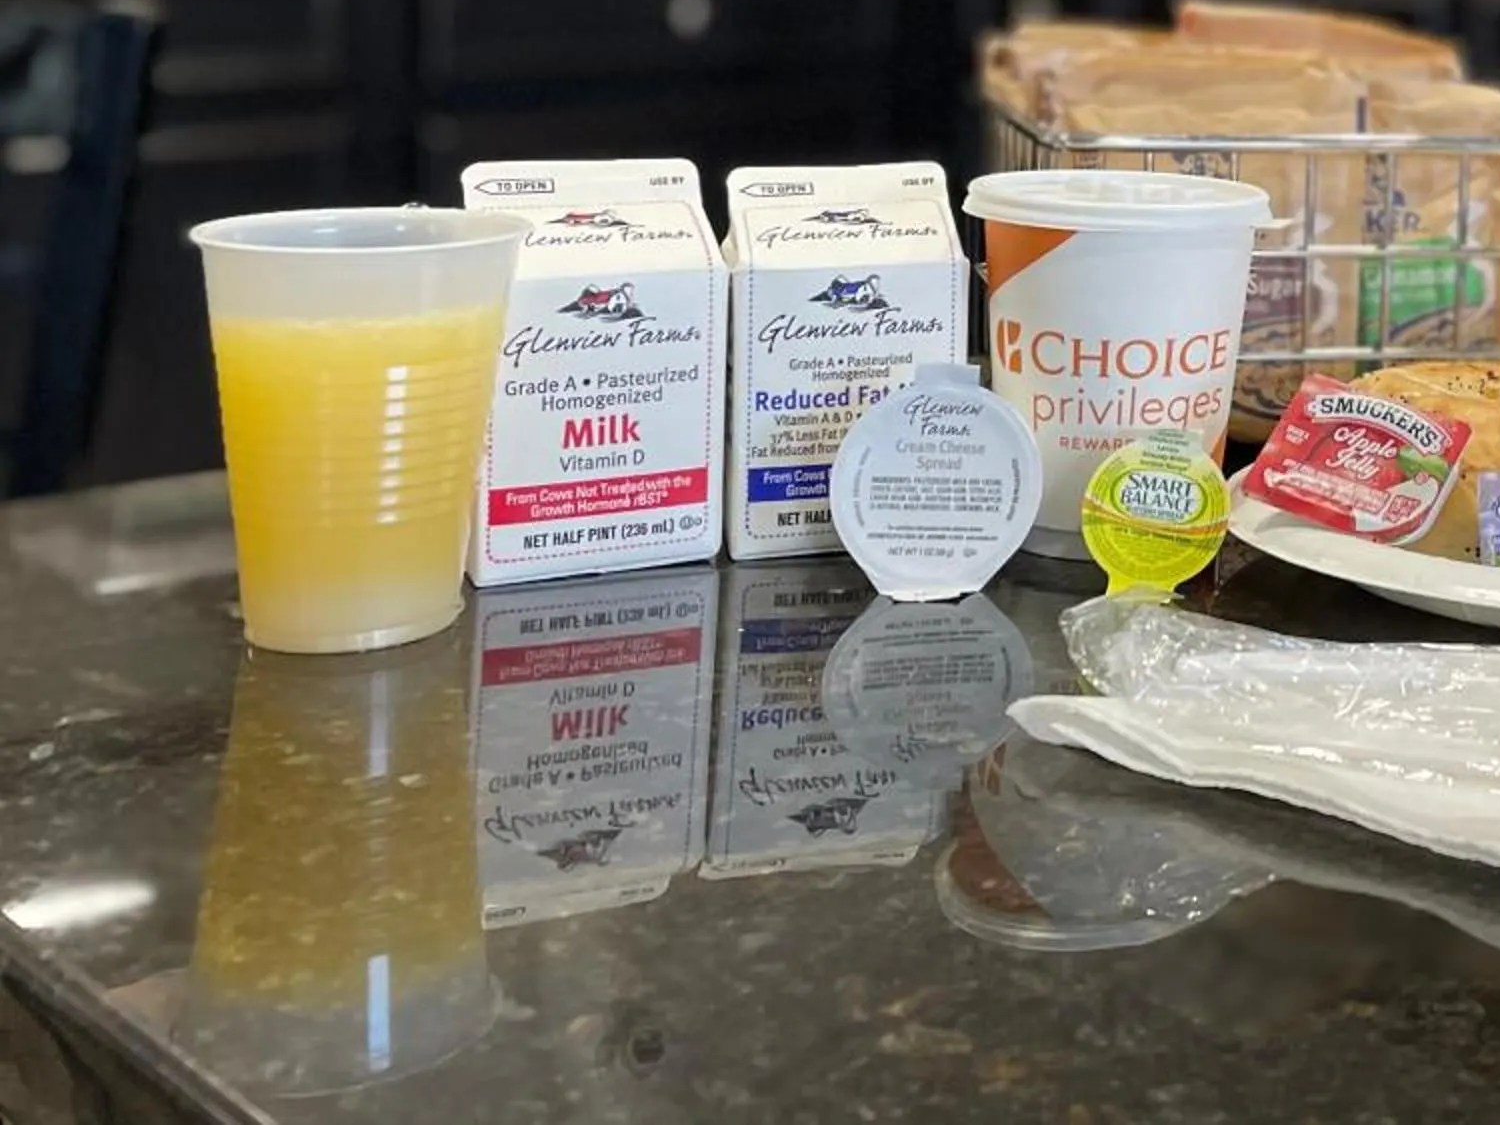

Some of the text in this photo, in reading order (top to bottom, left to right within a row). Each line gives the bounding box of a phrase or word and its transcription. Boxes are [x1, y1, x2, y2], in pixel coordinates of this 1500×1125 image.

[497, 181, 547, 192] TO OPEN
[650, 176, 684, 186] USE BY
[525, 229, 613, 247] lenview
[756, 226, 860, 248] Glenview
[758, 307, 943, 353] Glenview Farms
[504, 317, 700, 367] Glenview Farms
[789, 353, 913, 371] Grade A Pasteurized
[1031, 329, 1230, 379] CHOICE
[504, 365, 699, 397] Grade A Pasteurized
[812, 367, 889, 381] Homogenized
[541, 386, 663, 412] Homogenized
[755, 386, 849, 411] Reduced
[903, 394, 983, 425] Glenview
[1032, 387, 1222, 432] privileges
[774, 413, 818, 425] Vitamin
[821, 413, 830, 423] A
[844, 411, 853, 422] D
[921, 414, 971, 436] Farms
[1321, 397, 1439, 448] SMUCKER'S
[562, 413, 641, 450] Milk
[796, 430, 819, 441] Less
[822, 428, 837, 439] Fat
[1334, 427, 1397, 458] Apple
[751, 446, 768, 457] Fat
[770, 444, 815, 457] Reduced
[895, 439, 985, 454] Cream Cheese
[560, 449, 645, 472] Vitamin D
[916, 456, 962, 471] Spread
[1326, 447, 1380, 480] Jelly
[763, 472, 792, 484] From
[1128, 473, 1193, 497] SMART
[506, 492, 537, 506] From
[539, 488, 574, 502] Cows
[576, 484, 598, 499] Not
[600, 479, 643, 495] Treated
[673, 475, 692, 487] the
[786, 484, 826, 497] Growth
[1121, 487, 1194, 513] BALANCE
[531, 503, 575, 517] Growth
[577, 497, 630, 514] Hormone
[777, 512, 799, 526] NET
[523, 535, 547, 549] NET
[553, 531, 585, 546] HALF
[588, 527, 617, 542] PINT
[621, 523, 647, 539] (236
